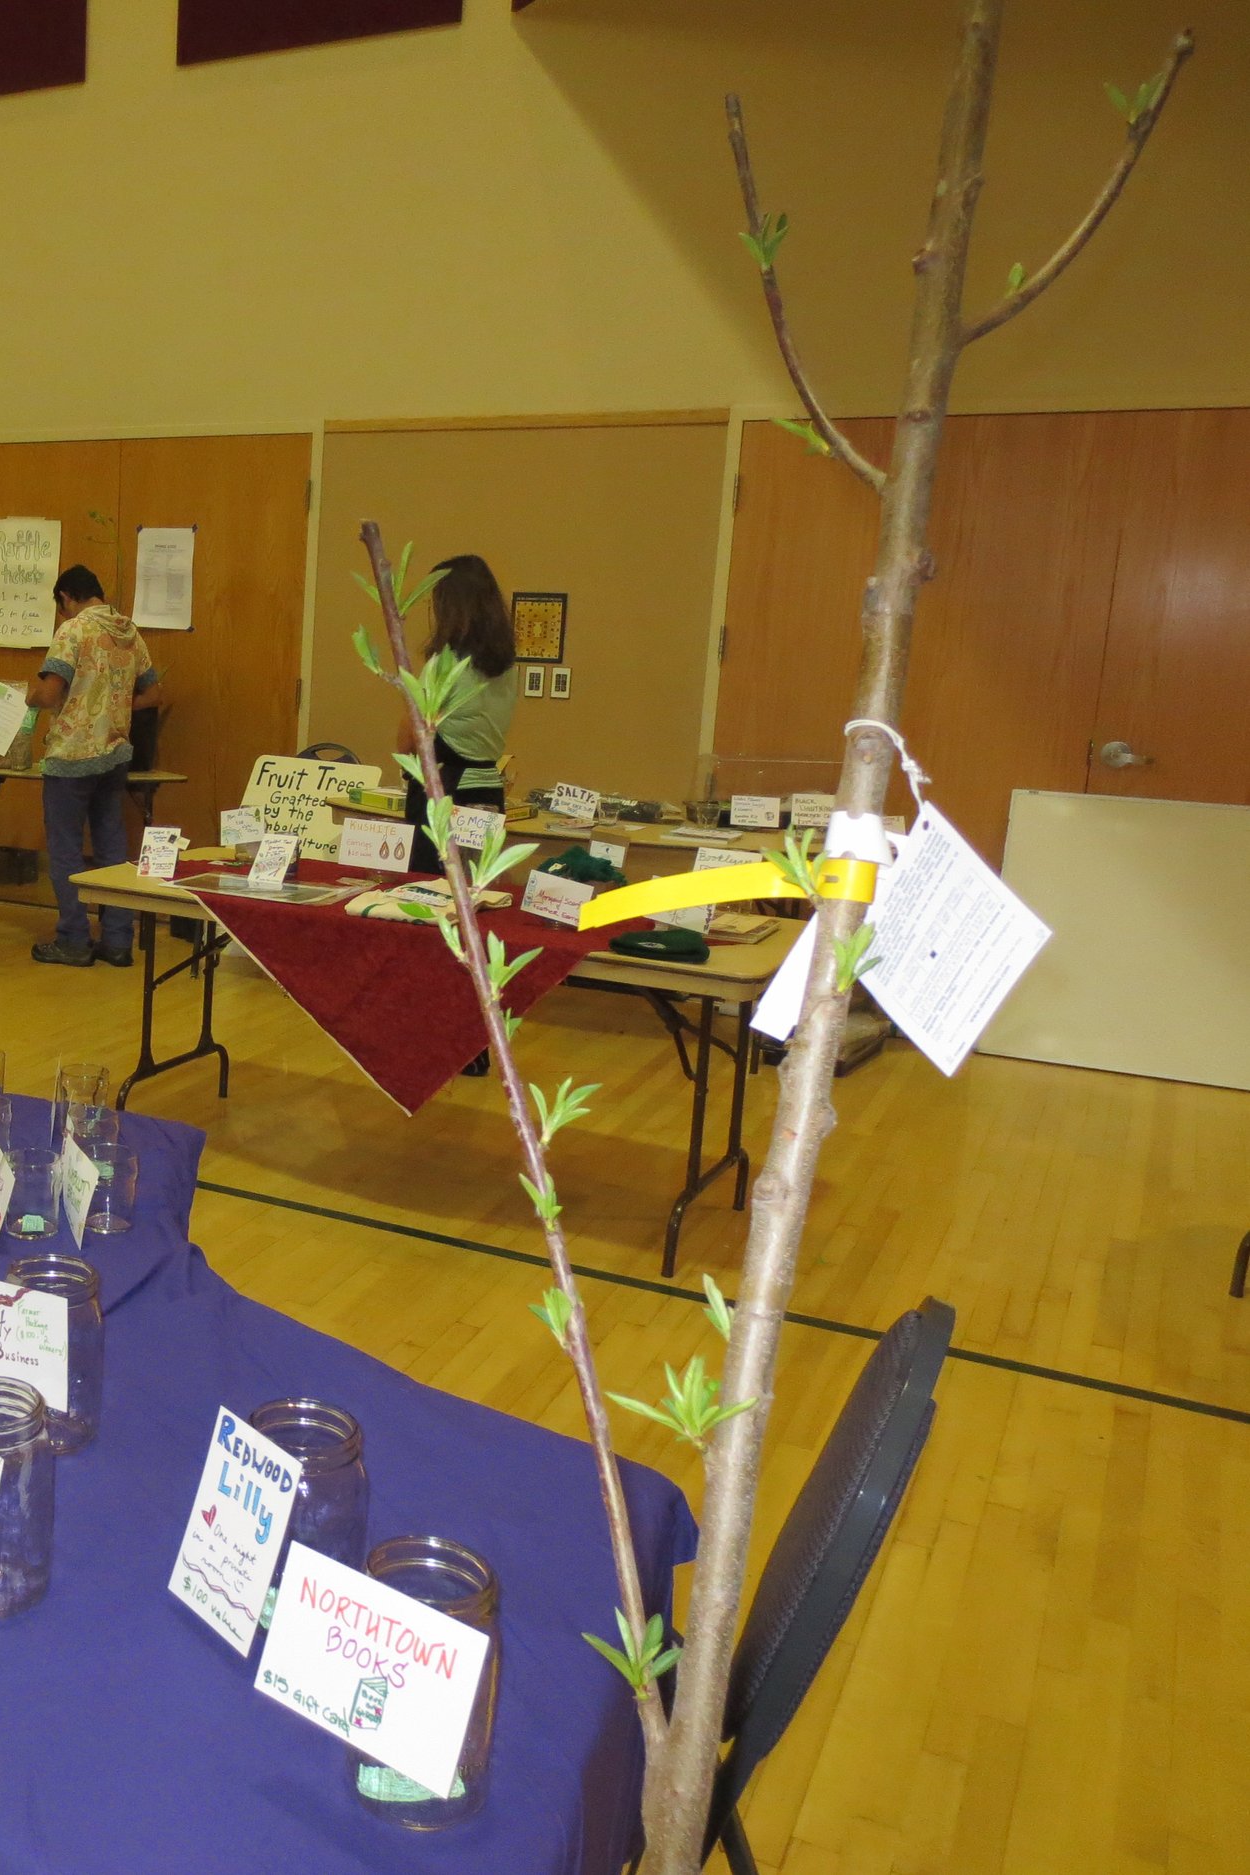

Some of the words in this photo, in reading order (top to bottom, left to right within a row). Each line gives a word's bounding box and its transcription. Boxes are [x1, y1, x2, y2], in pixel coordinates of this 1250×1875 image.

[256, 761, 309, 791] Fruit
[317, 765, 365, 795] Trees
[270, 790, 327, 808] Grafted
[264, 804, 281, 819] by
[288, 806, 314, 822] the
[217, 1414, 293, 1493] REDWOOD
[217, 1460, 274, 1545] Lilly
[213, 1522, 229, 1545] One
[232, 1541, 258, 1567] night
[220, 1555, 253, 1582] private
[182, 1575, 209, 1606] $100
[210, 1603, 245, 1643] value
[300, 1576, 458, 1679] NORTHTOWN
[325, 1625, 410, 1689] BOOKS
[263, 1669, 289, 1694] $15
